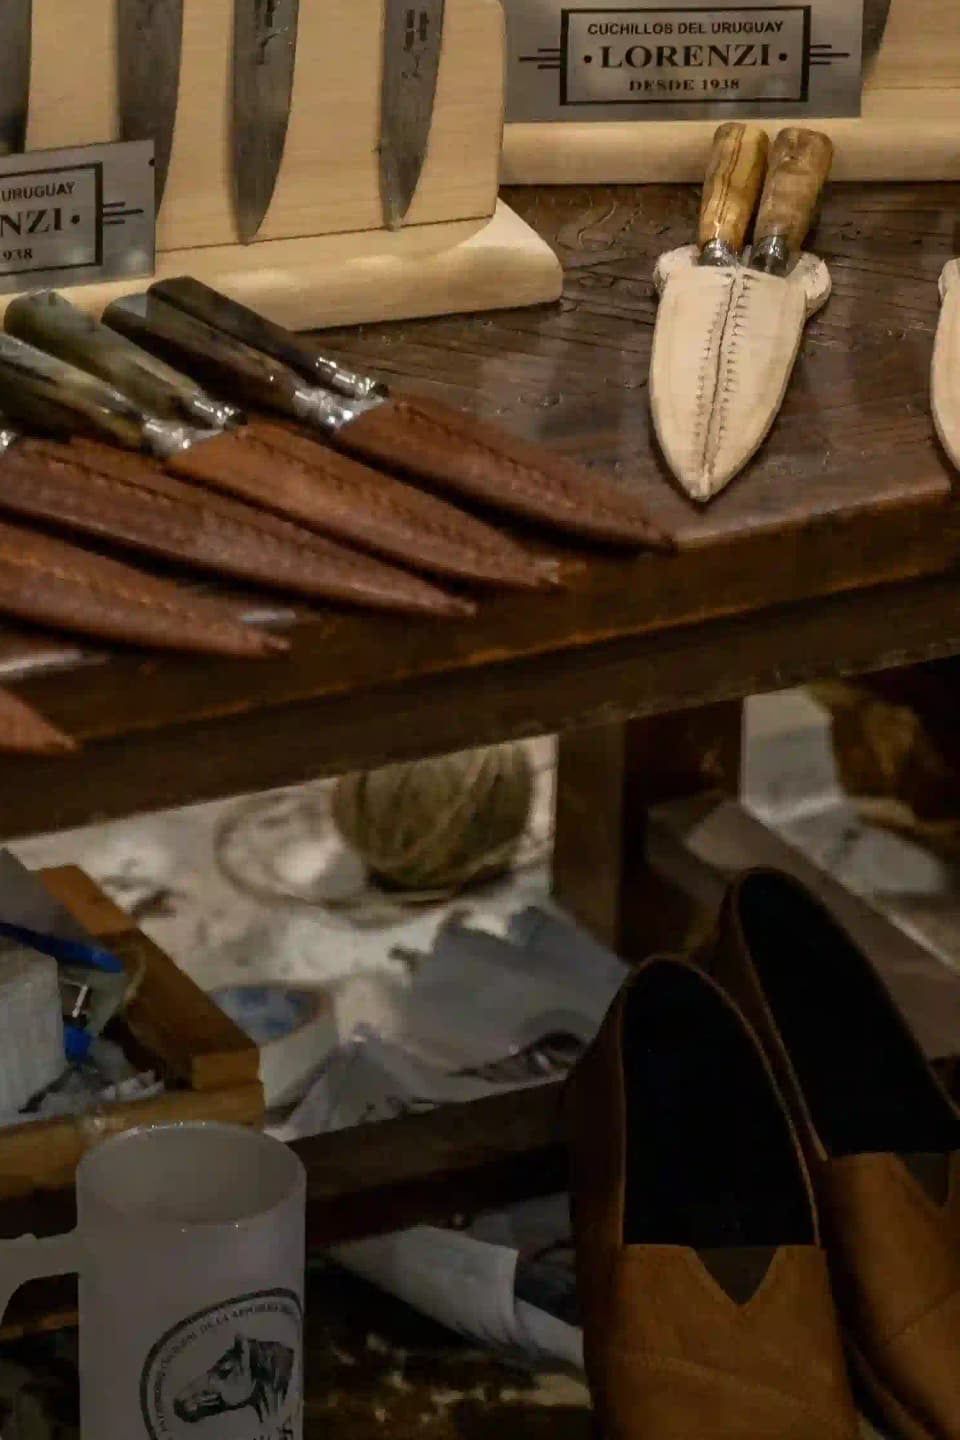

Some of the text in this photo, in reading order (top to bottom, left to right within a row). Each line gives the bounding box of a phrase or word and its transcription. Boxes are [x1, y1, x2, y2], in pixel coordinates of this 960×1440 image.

[586, 20, 784, 36] CUCHILLOS DEL URUGUAY
[628, 78, 741, 92] DESDE 1938
[0, 181, 76, 203] URUGUAY
